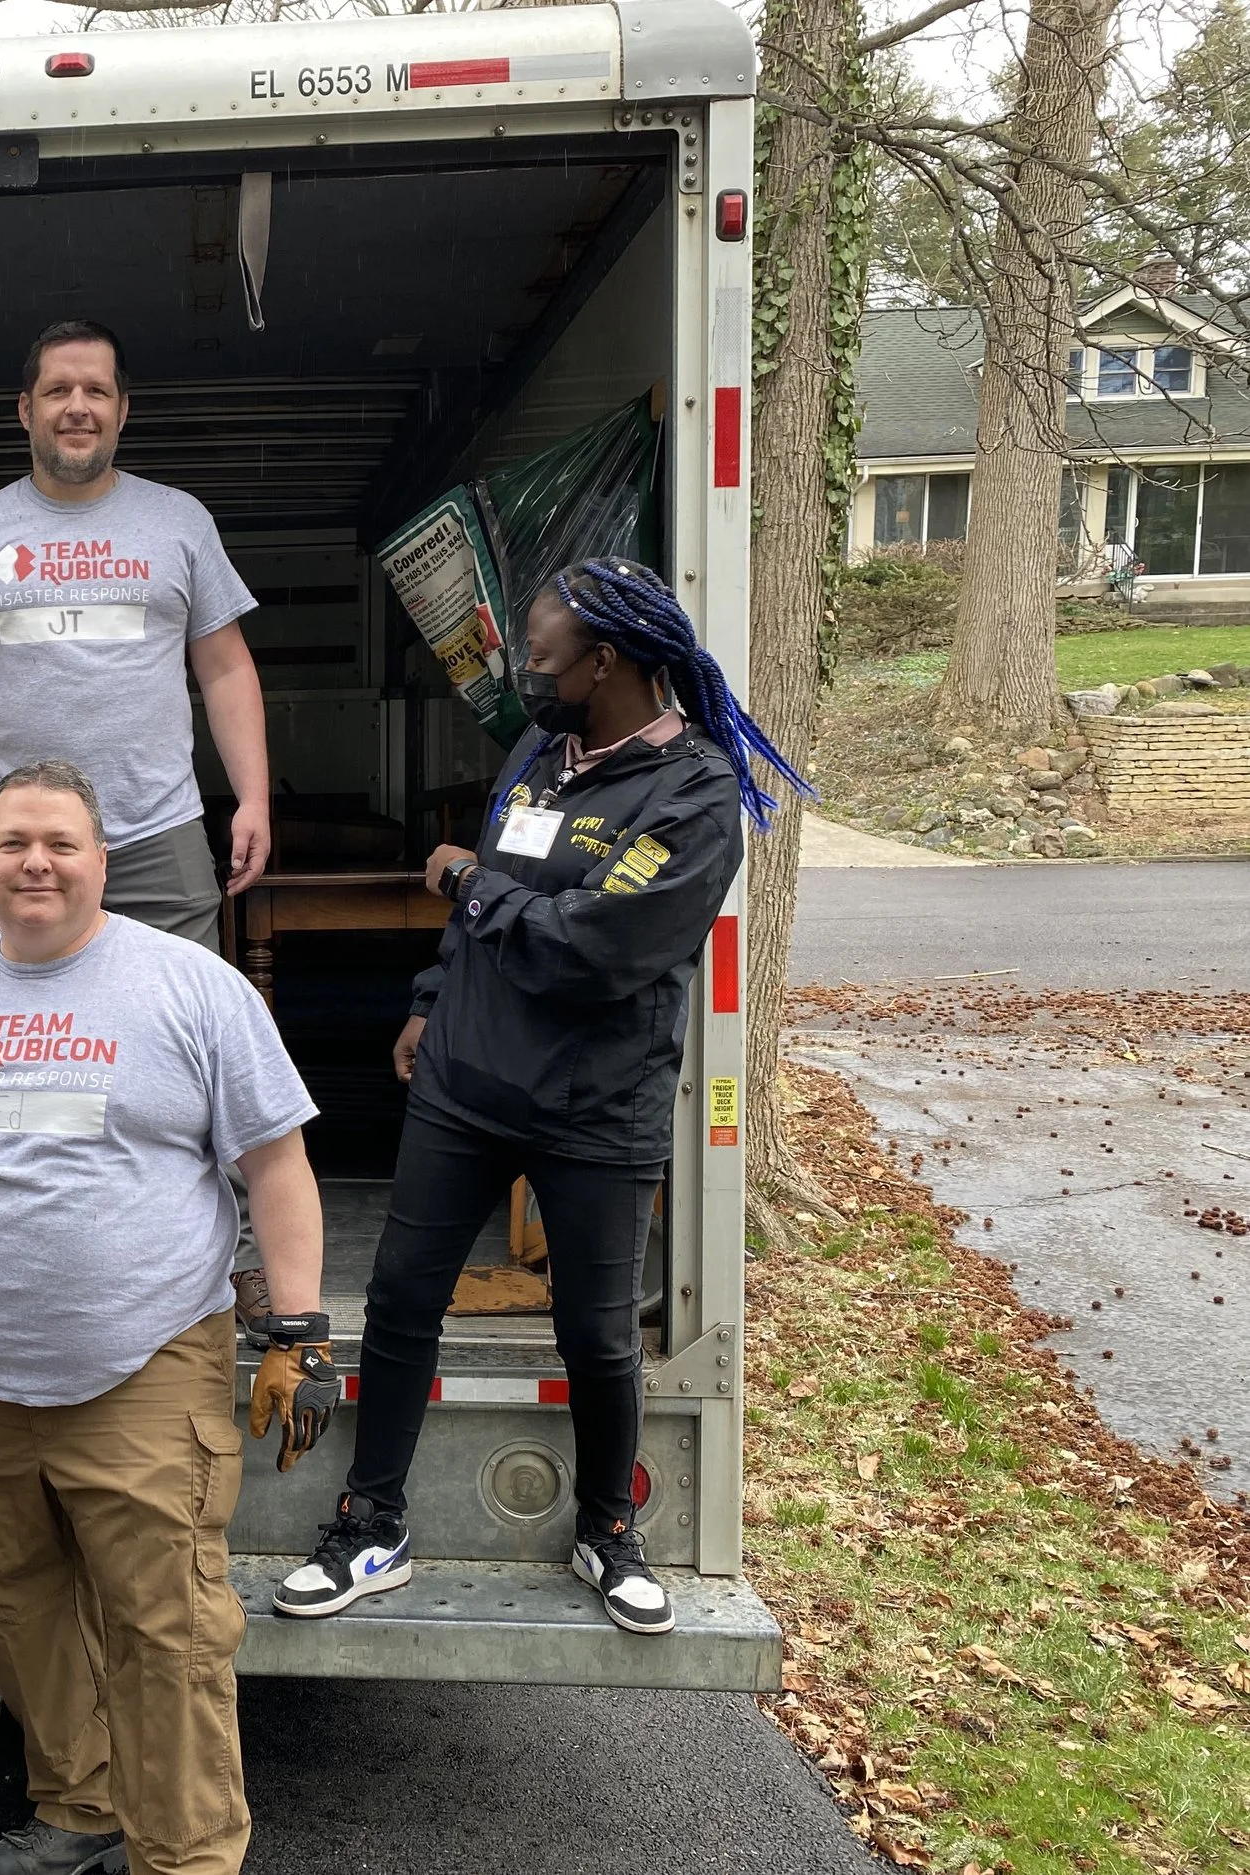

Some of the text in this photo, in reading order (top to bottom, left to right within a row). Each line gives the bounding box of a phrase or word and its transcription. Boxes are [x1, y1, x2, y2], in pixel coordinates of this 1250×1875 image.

[251, 63, 409, 99] EL 6553 M
[41, 539, 111, 560] TEAM
[393, 523, 450, 572] Covered!
[40, 559, 149, 586] RUBICON
[405, 567, 421, 582] PADS
[421, 561, 430, 570] IN
[429, 547, 447, 563] THIS
[70, 587, 150, 602] RESPONSE
[48, 609, 83, 635] JT
[11, 1071, 114, 1090] RESPONSE
